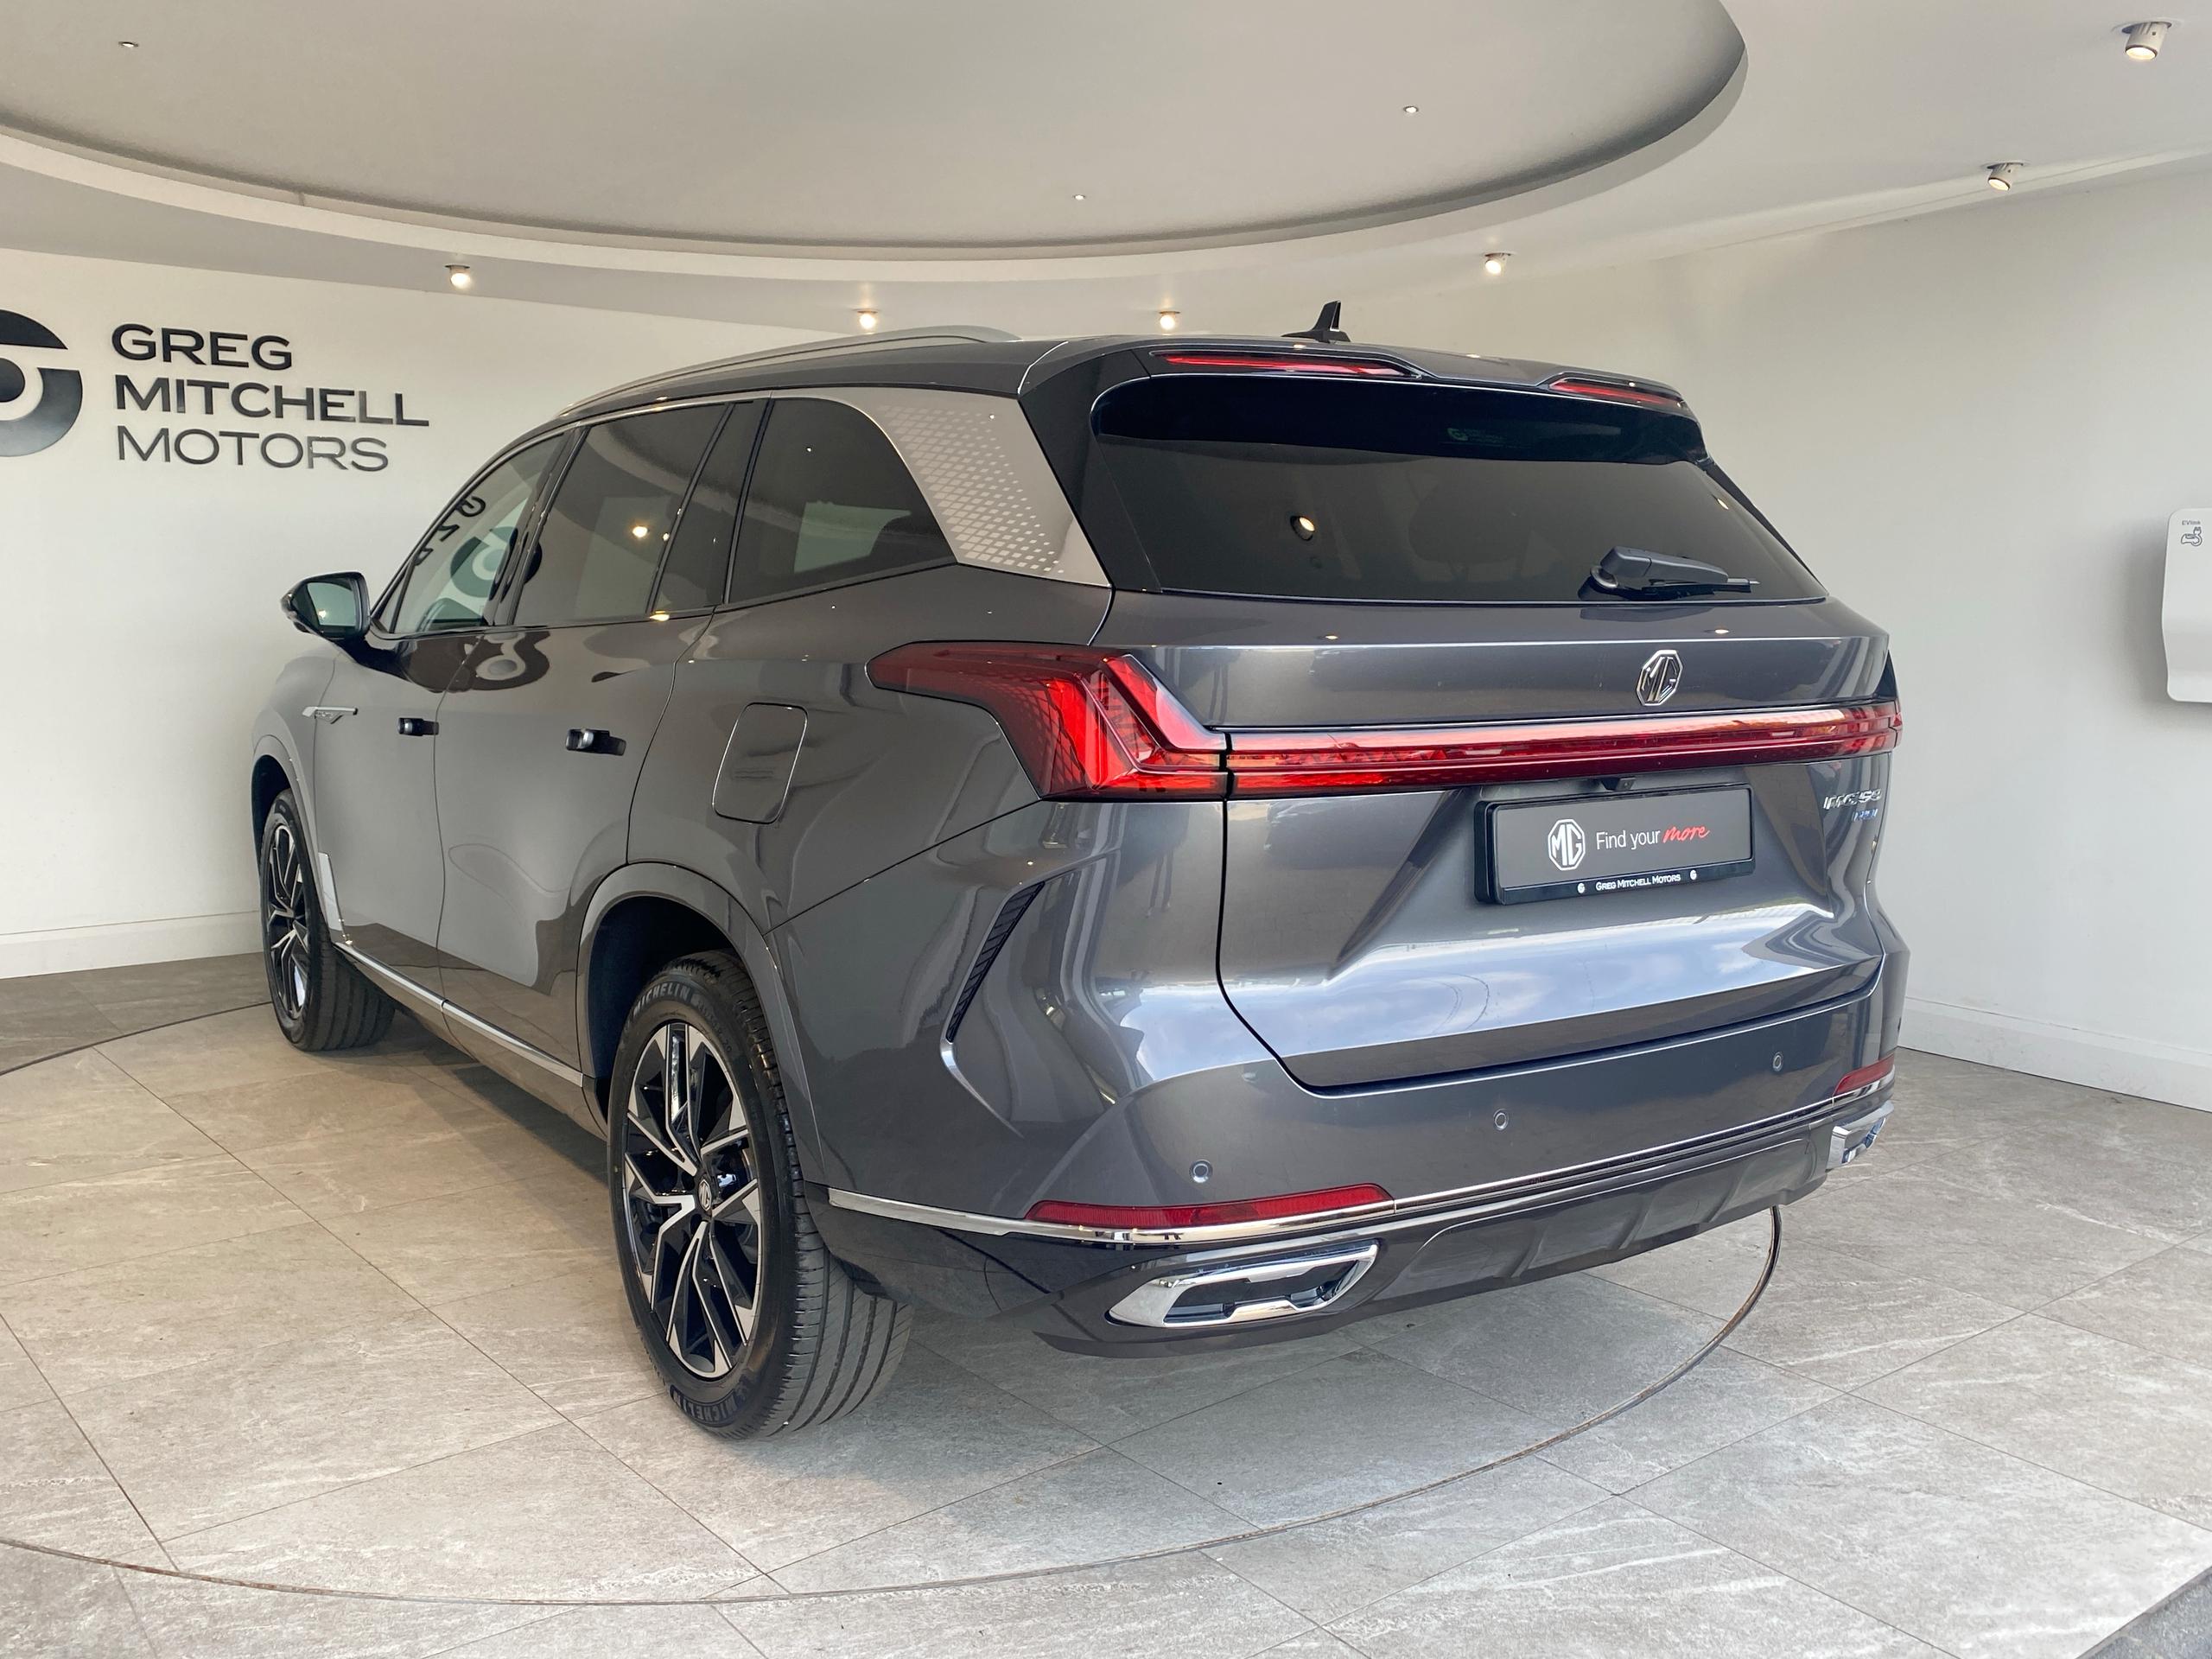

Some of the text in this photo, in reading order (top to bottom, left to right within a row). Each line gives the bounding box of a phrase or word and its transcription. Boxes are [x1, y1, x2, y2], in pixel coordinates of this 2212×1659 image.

[111, 322, 292, 371] GREG
[115, 374, 429, 427] MITCHELL
[118, 425, 388, 472] MOTORS
[1638, 653, 1681, 703] MG
[1549, 821, 1584, 868] MG
[1596, 824, 1710, 851] Find your more
[1596, 874, 1681, 891] GREG MITCHELL MOTORS
[632, 982, 691, 1019] MICHELIN
[672, 1390, 738, 1422] MICHELIN
